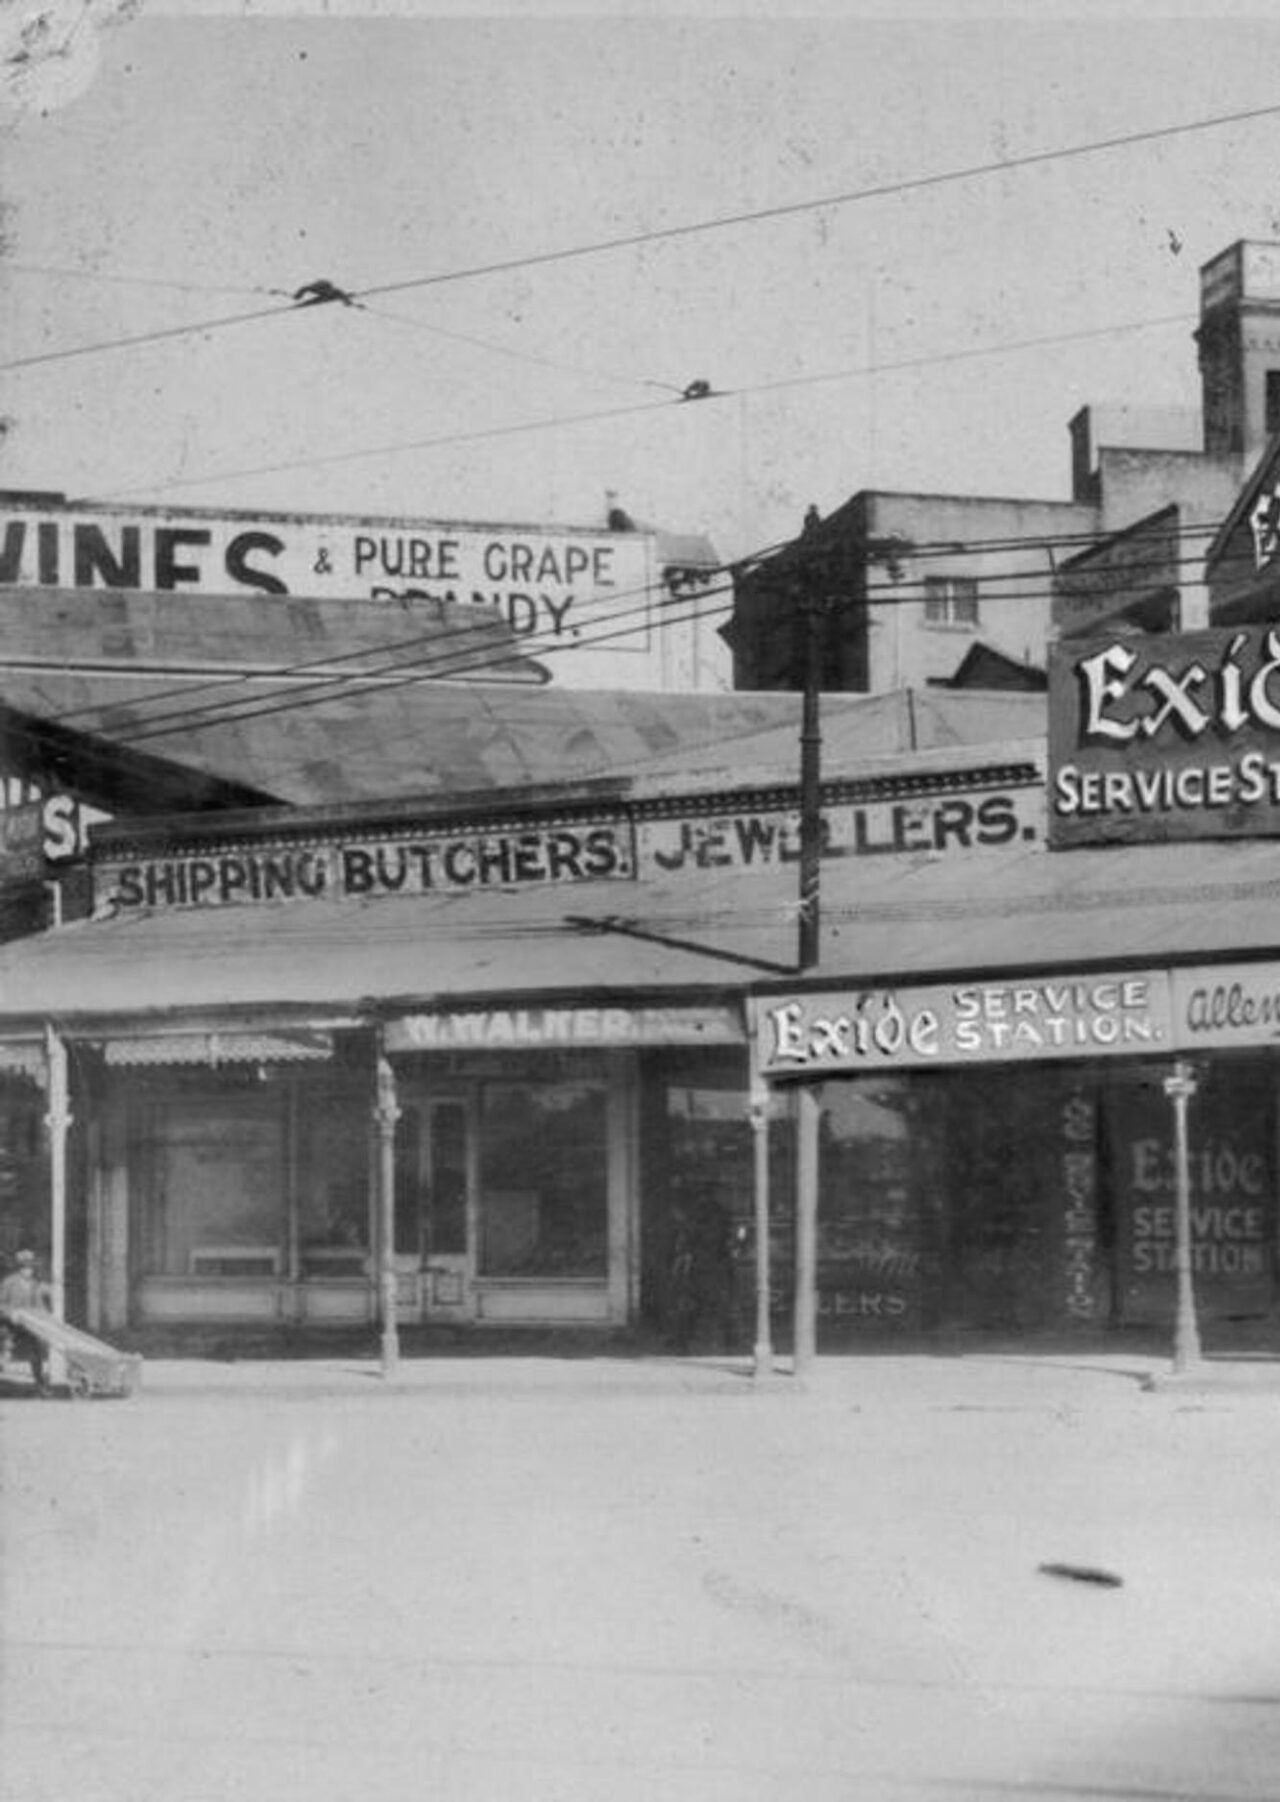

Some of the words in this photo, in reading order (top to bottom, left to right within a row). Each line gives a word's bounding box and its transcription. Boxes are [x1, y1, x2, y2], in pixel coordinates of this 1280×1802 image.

[313, 547, 333, 574] &
[355, 536, 459, 579] PURE
[483, 541, 615, 587] GRAPE
[1056, 764, 1231, 814] SERVICE
[108, 852, 327, 907] SHIPPING
[344, 830, 628, 894] BUTCHERS.
[767, 989, 940, 1065] Exide
[953, 980, 1149, 1019] SERVICE
[955, 1014, 1165, 1050] STATION.
[1133, 1206, 1264, 1240] SEVICE
